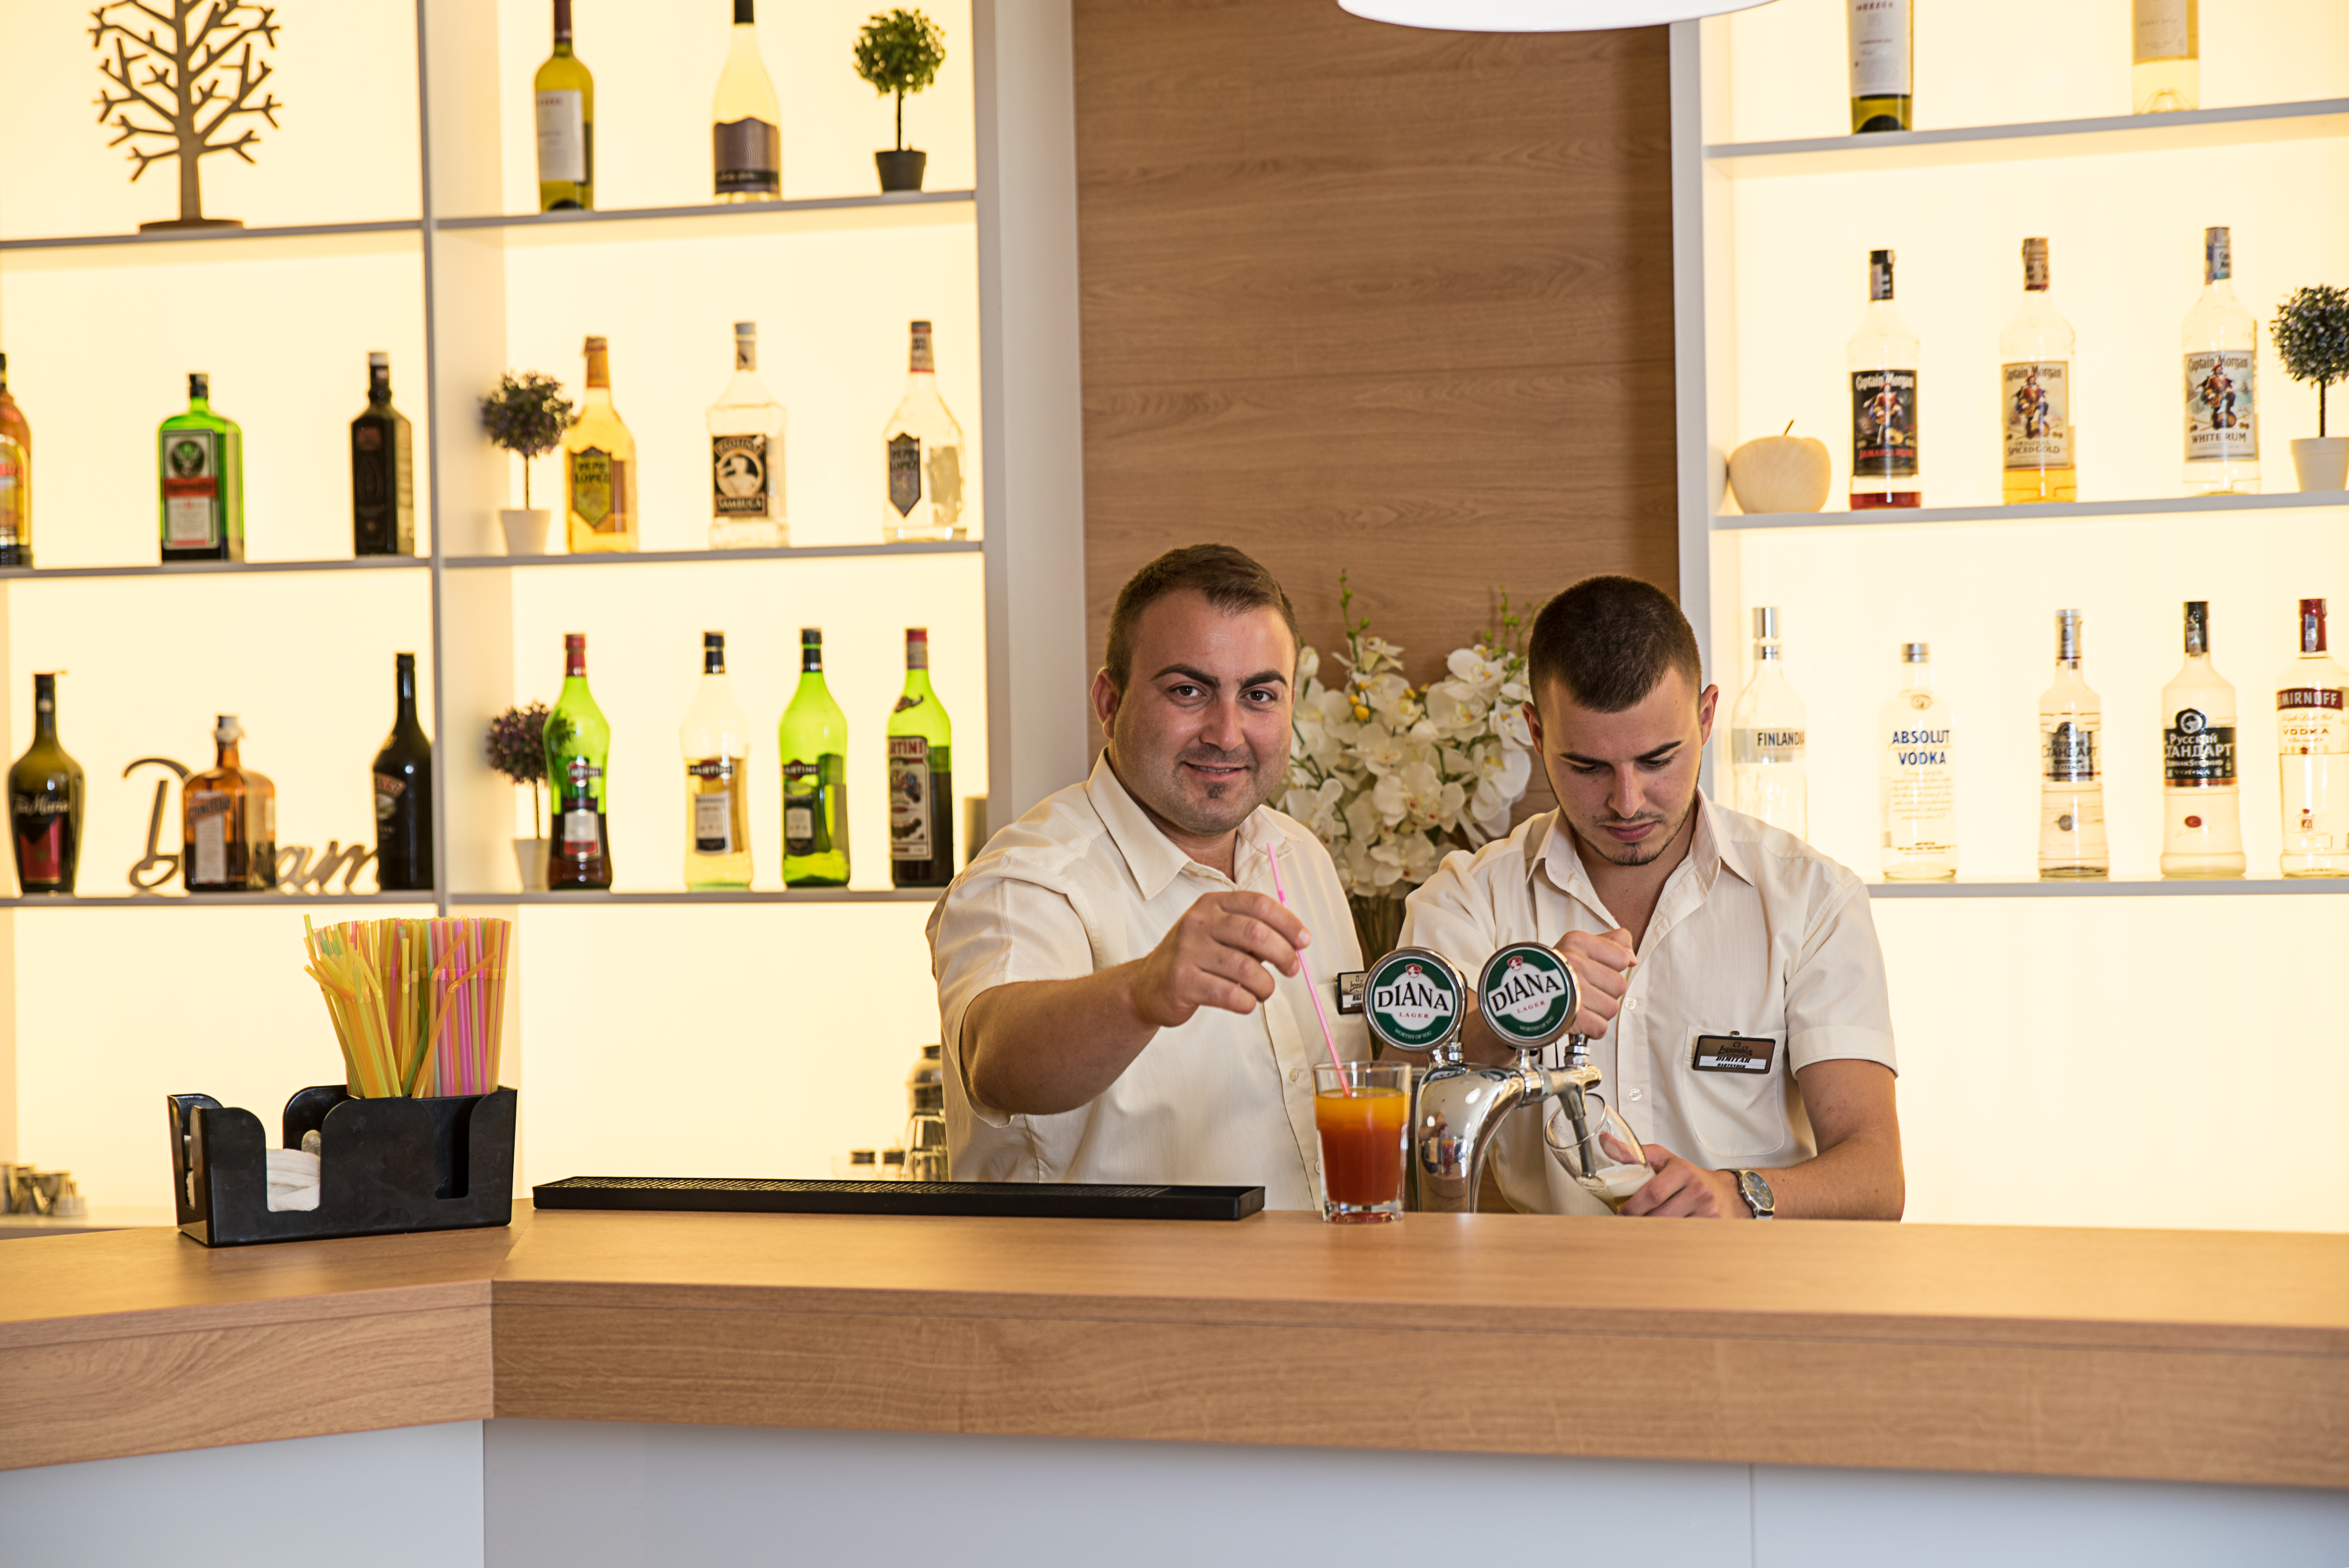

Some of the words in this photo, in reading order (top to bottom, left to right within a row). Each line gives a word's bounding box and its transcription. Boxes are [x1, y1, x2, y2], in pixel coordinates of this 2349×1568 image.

[2188, 356, 2215, 373] Captain
[1856, 374, 1884, 391] Captain
[2191, 433, 2221, 444] WHITE
[2225, 432, 2246, 442] RUM
[2007, 447, 2034, 456] SPICED
[2035, 445, 2060, 454] GOLD
[1893, 731, 1950, 744] ABSOLUT
[890, 740, 923, 755] RTINI
[2165, 743, 2233, 757] ТАНДАРТ
[1899, 752, 1946, 765] VODKA
[783, 765, 816, 774] ARTINI
[1377, 982, 1449, 1011] DIANA
[1491, 973, 1561, 1012] DIANA
[1517, 1000, 1545, 1014] LAGER
[1395, 1028, 1414, 1039] WORTHY
